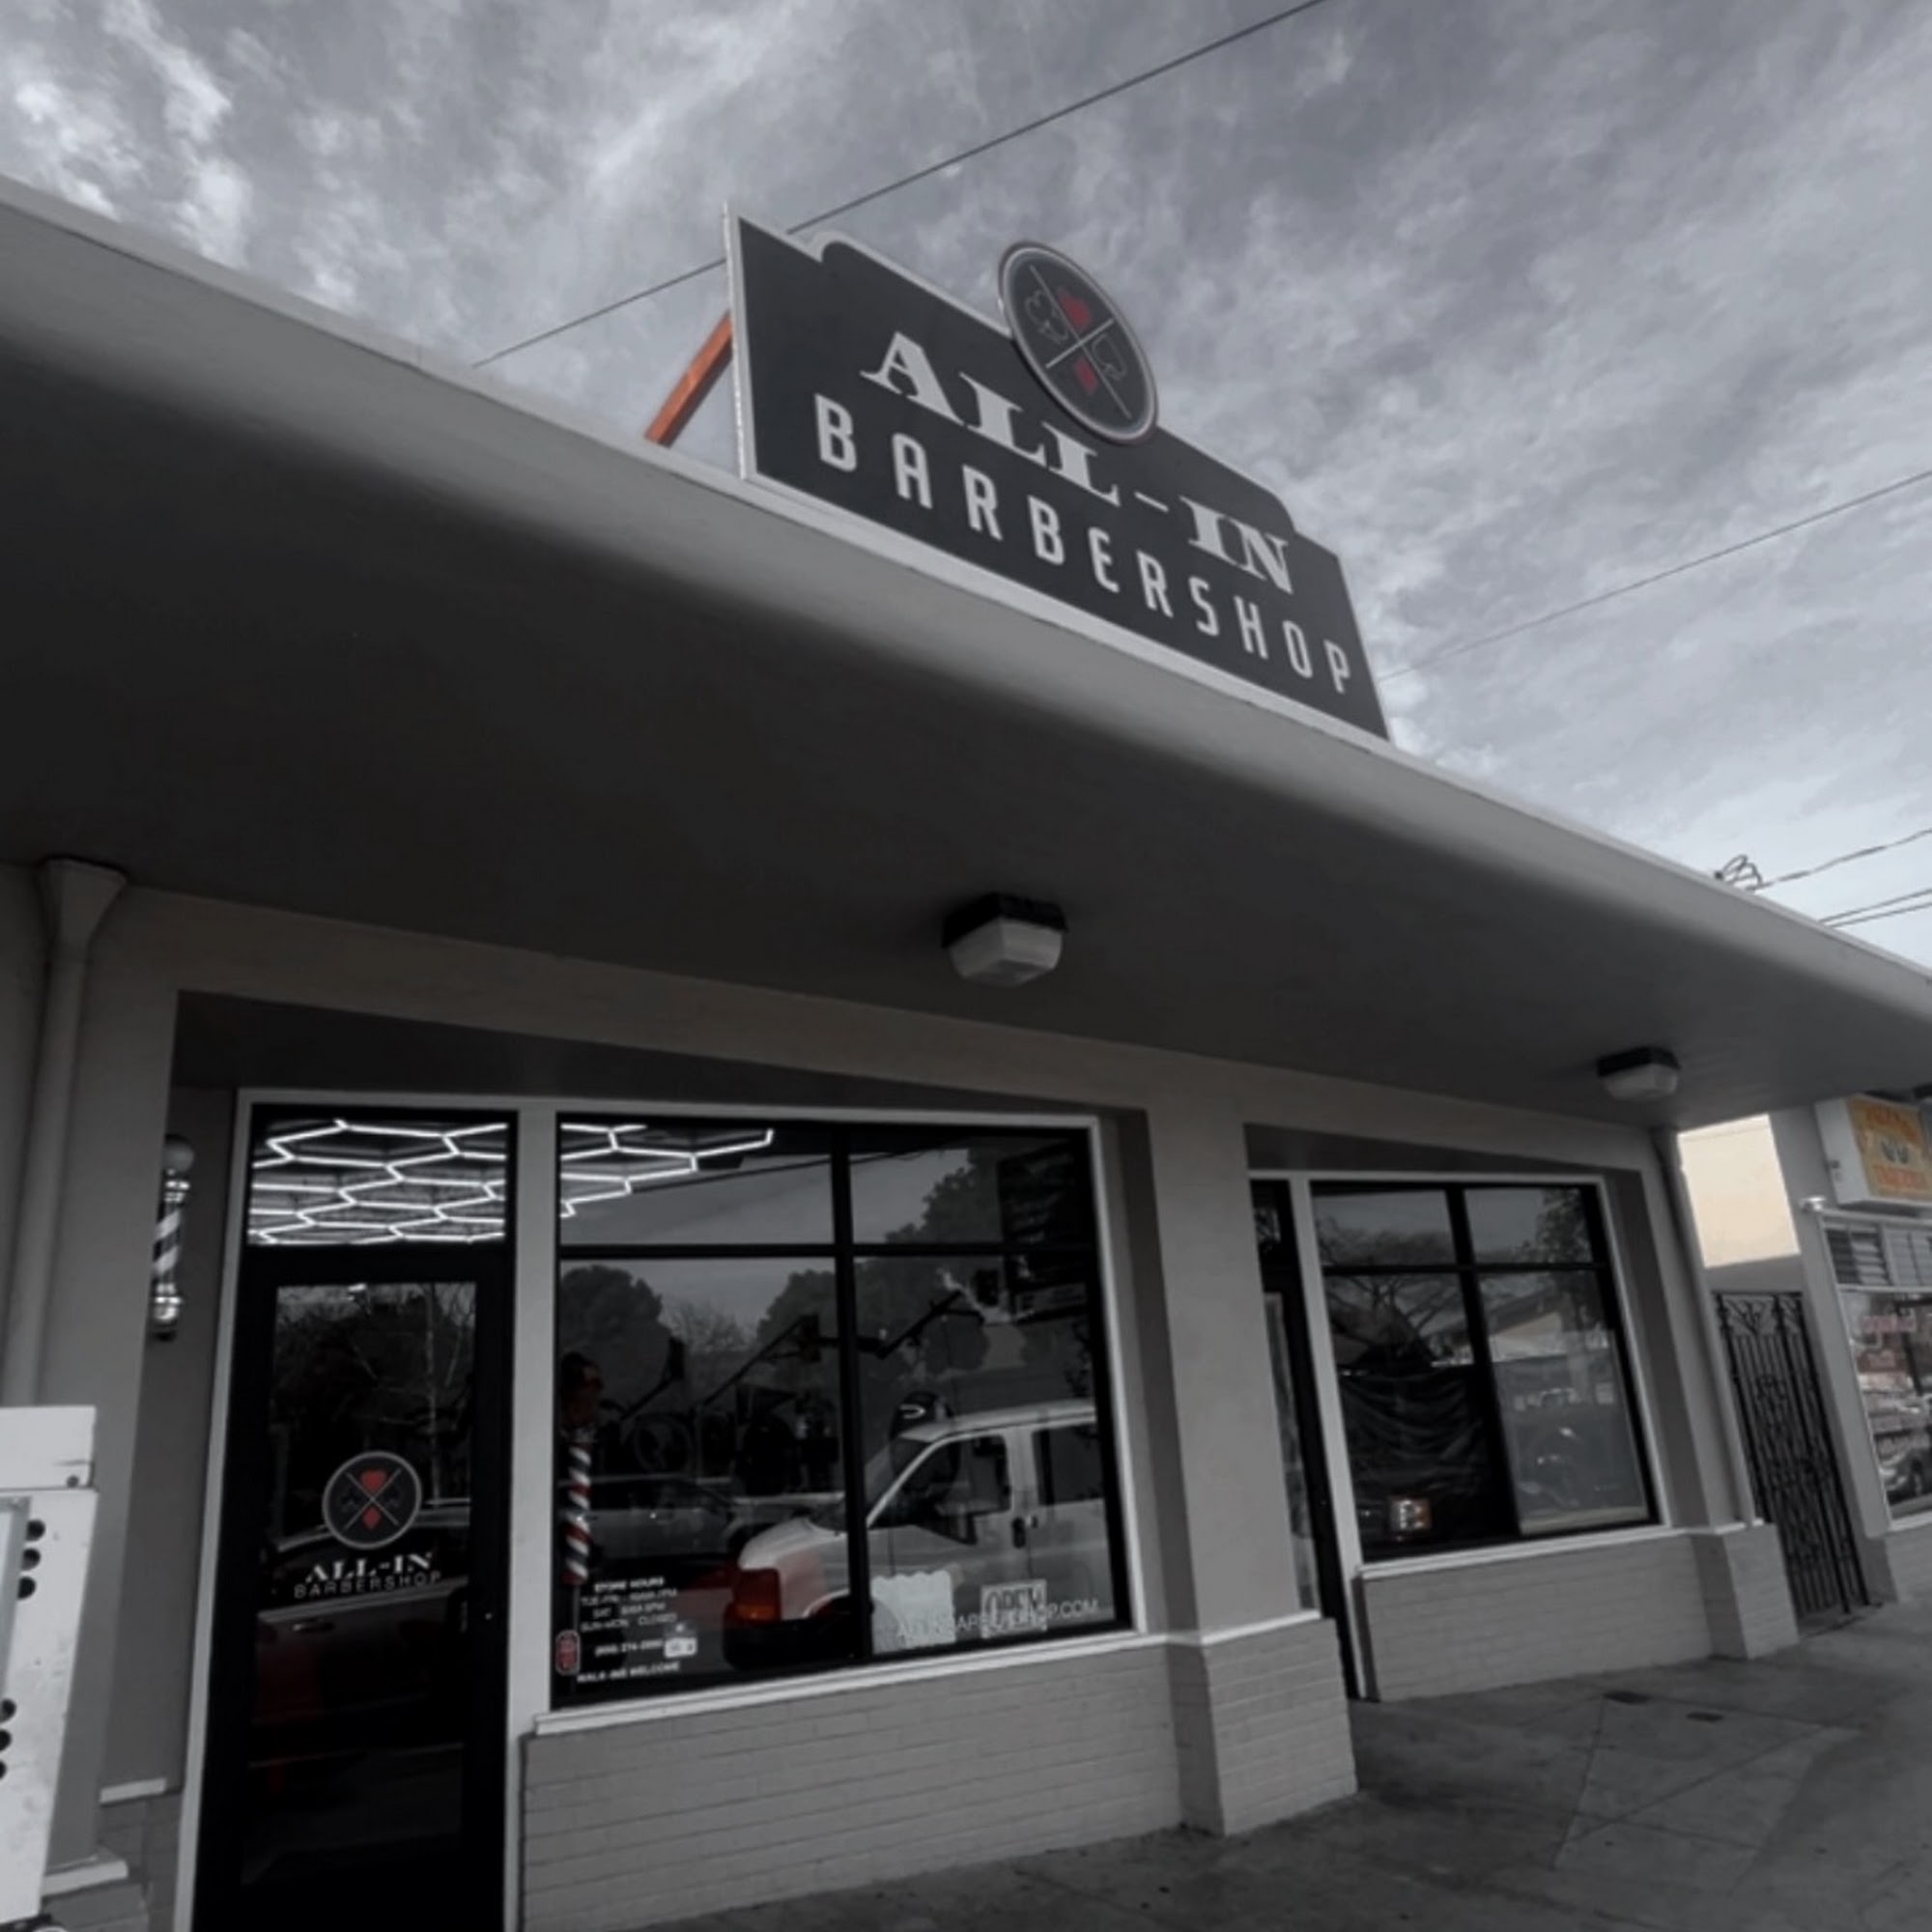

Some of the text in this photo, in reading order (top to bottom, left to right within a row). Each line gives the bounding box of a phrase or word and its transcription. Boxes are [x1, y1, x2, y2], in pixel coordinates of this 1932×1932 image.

[859, 331, 1293, 595] ALL-IN
[814, 393, 1350, 694] BARBERSHOP
[294, 1570, 441, 1599] BARBERSHOP
[305, 1551, 432, 1583] ALL-IN
